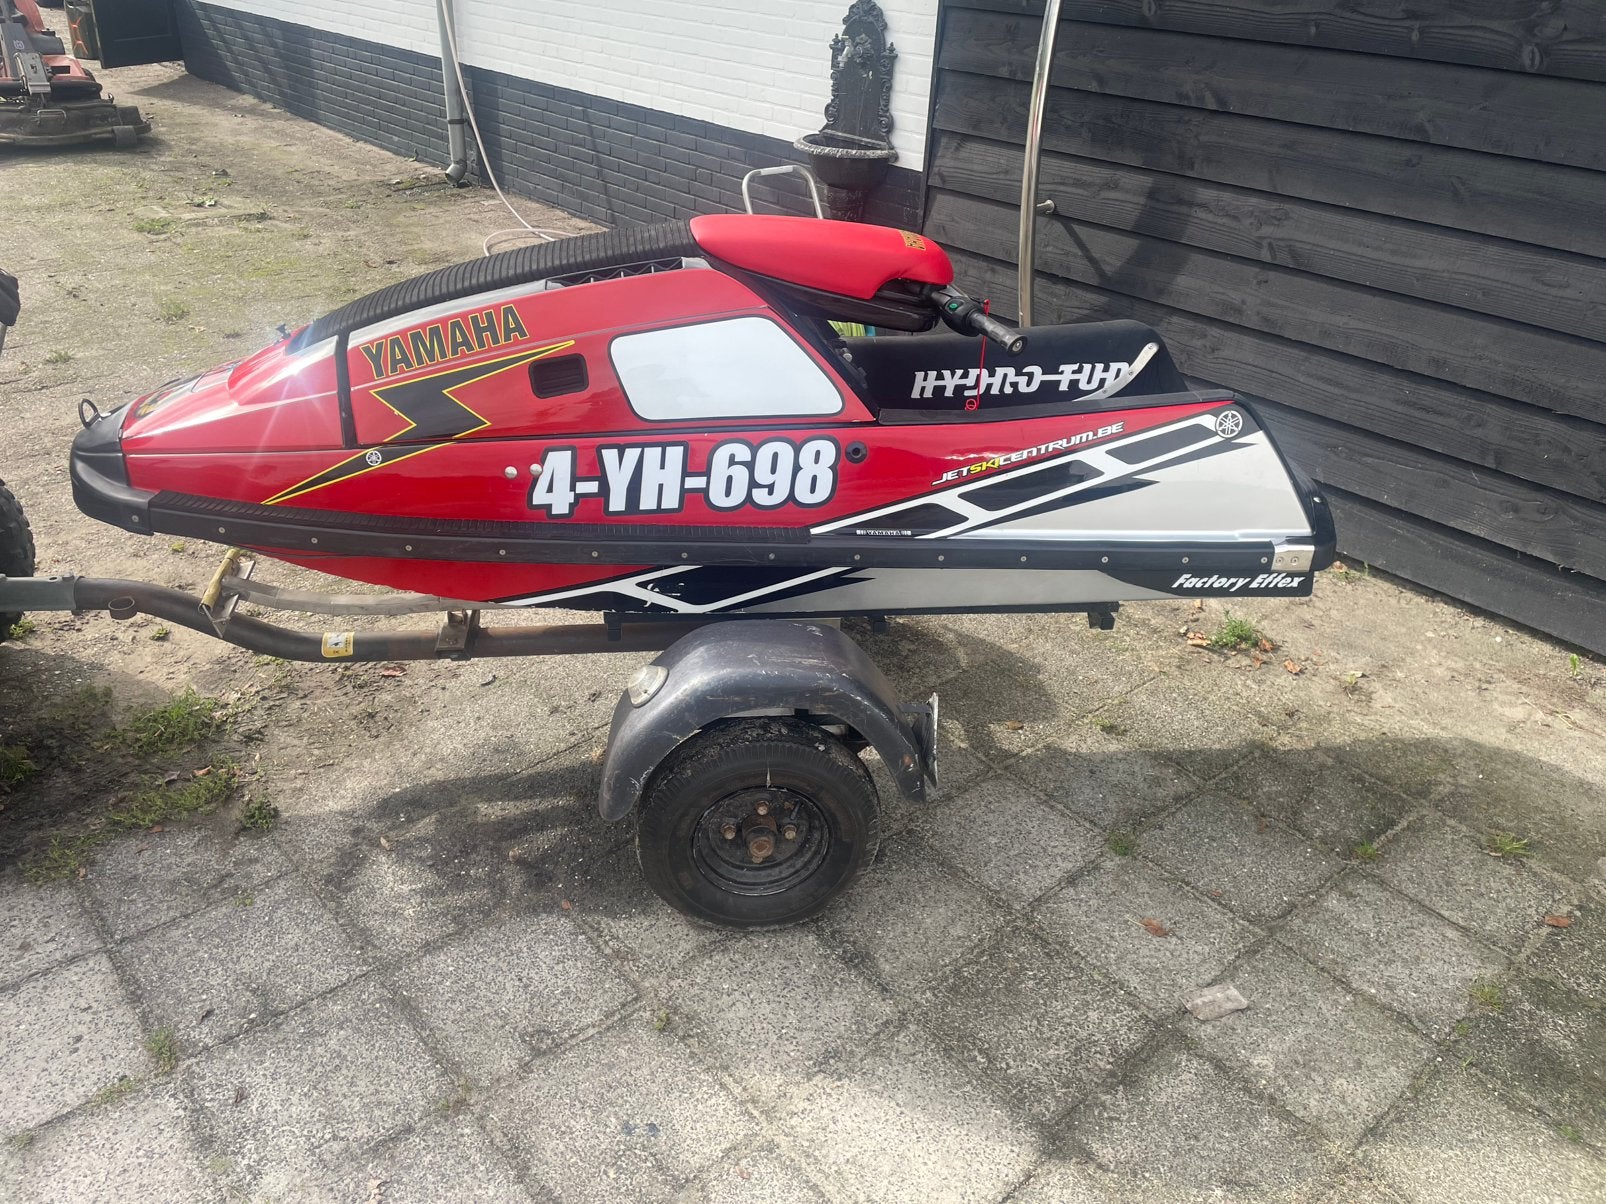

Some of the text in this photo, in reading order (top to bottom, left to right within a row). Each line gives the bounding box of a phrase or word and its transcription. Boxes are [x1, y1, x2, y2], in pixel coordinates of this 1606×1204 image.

[361, 304, 529, 379] YAMAHA
[531, 438, 838, 515] 4-YH-698
[932, 422, 1124, 485] JETSKICENTRUM.BE
[1171, 572, 1306, 592] Factory Effex
